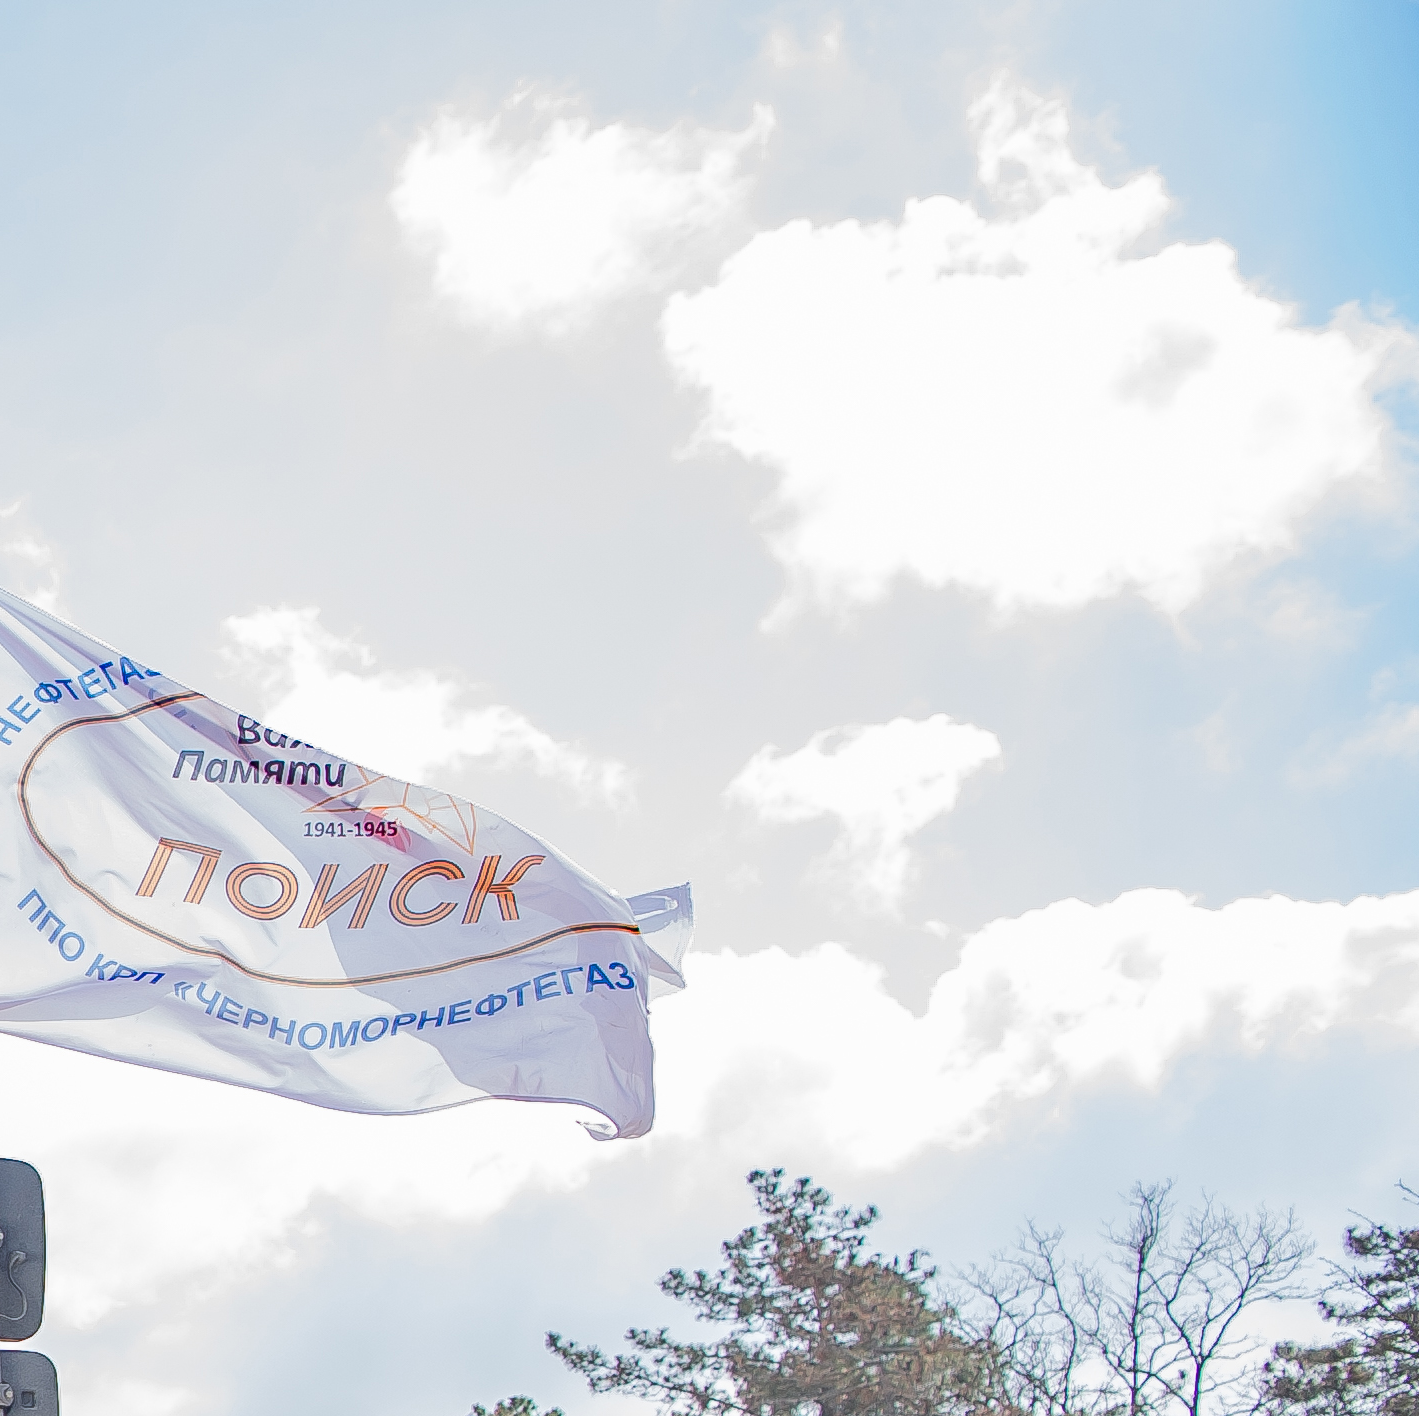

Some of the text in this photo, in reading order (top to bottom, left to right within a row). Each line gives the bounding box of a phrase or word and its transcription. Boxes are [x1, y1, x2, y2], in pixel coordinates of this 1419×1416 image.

[171, 750, 346, 788] Памяти
[302, 819, 398, 838] 1941-1945
[135, 836, 546, 930] ПОИСК
[16, 887, 637, 1051] ППО КРП «ЧЕРНОМОРНЕФТЕГАЗ
